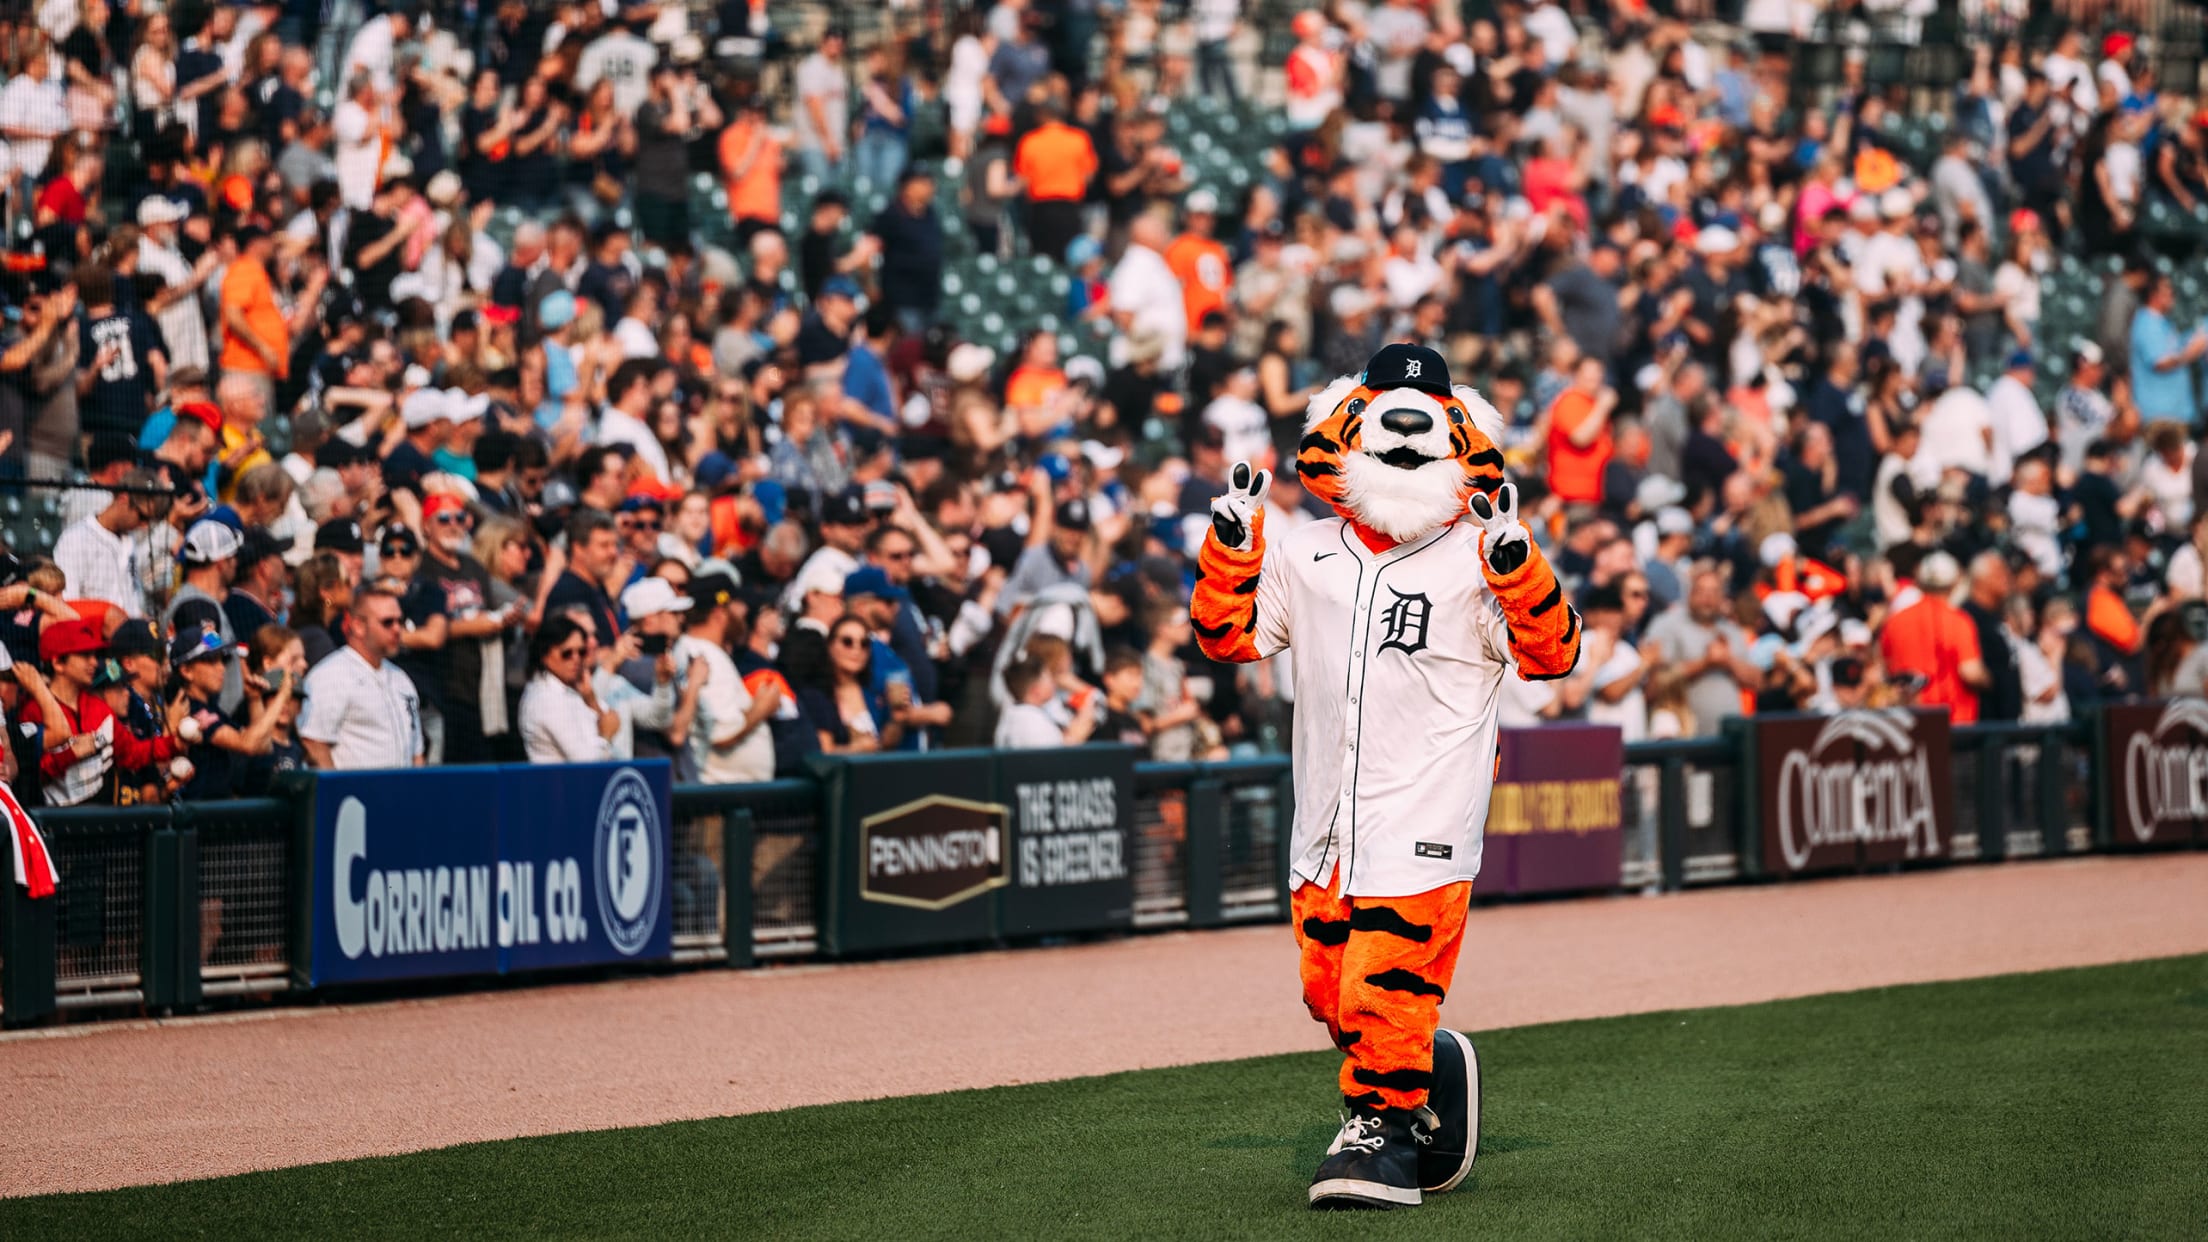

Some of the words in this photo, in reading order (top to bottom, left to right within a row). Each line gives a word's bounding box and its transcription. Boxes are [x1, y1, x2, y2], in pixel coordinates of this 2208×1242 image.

[1404, 358, 1422, 379] D
[1376, 583, 1433, 658] D
[1016, 782, 1053, 832] THE
[1055, 777, 1117, 830] GRASS
[2126, 731, 2208, 842] Come
[333, 795, 490, 960] CORRIGAN
[497, 860, 540, 947] OIL
[545, 857, 588, 944] CO.
[1018, 836, 1040, 887] IS
